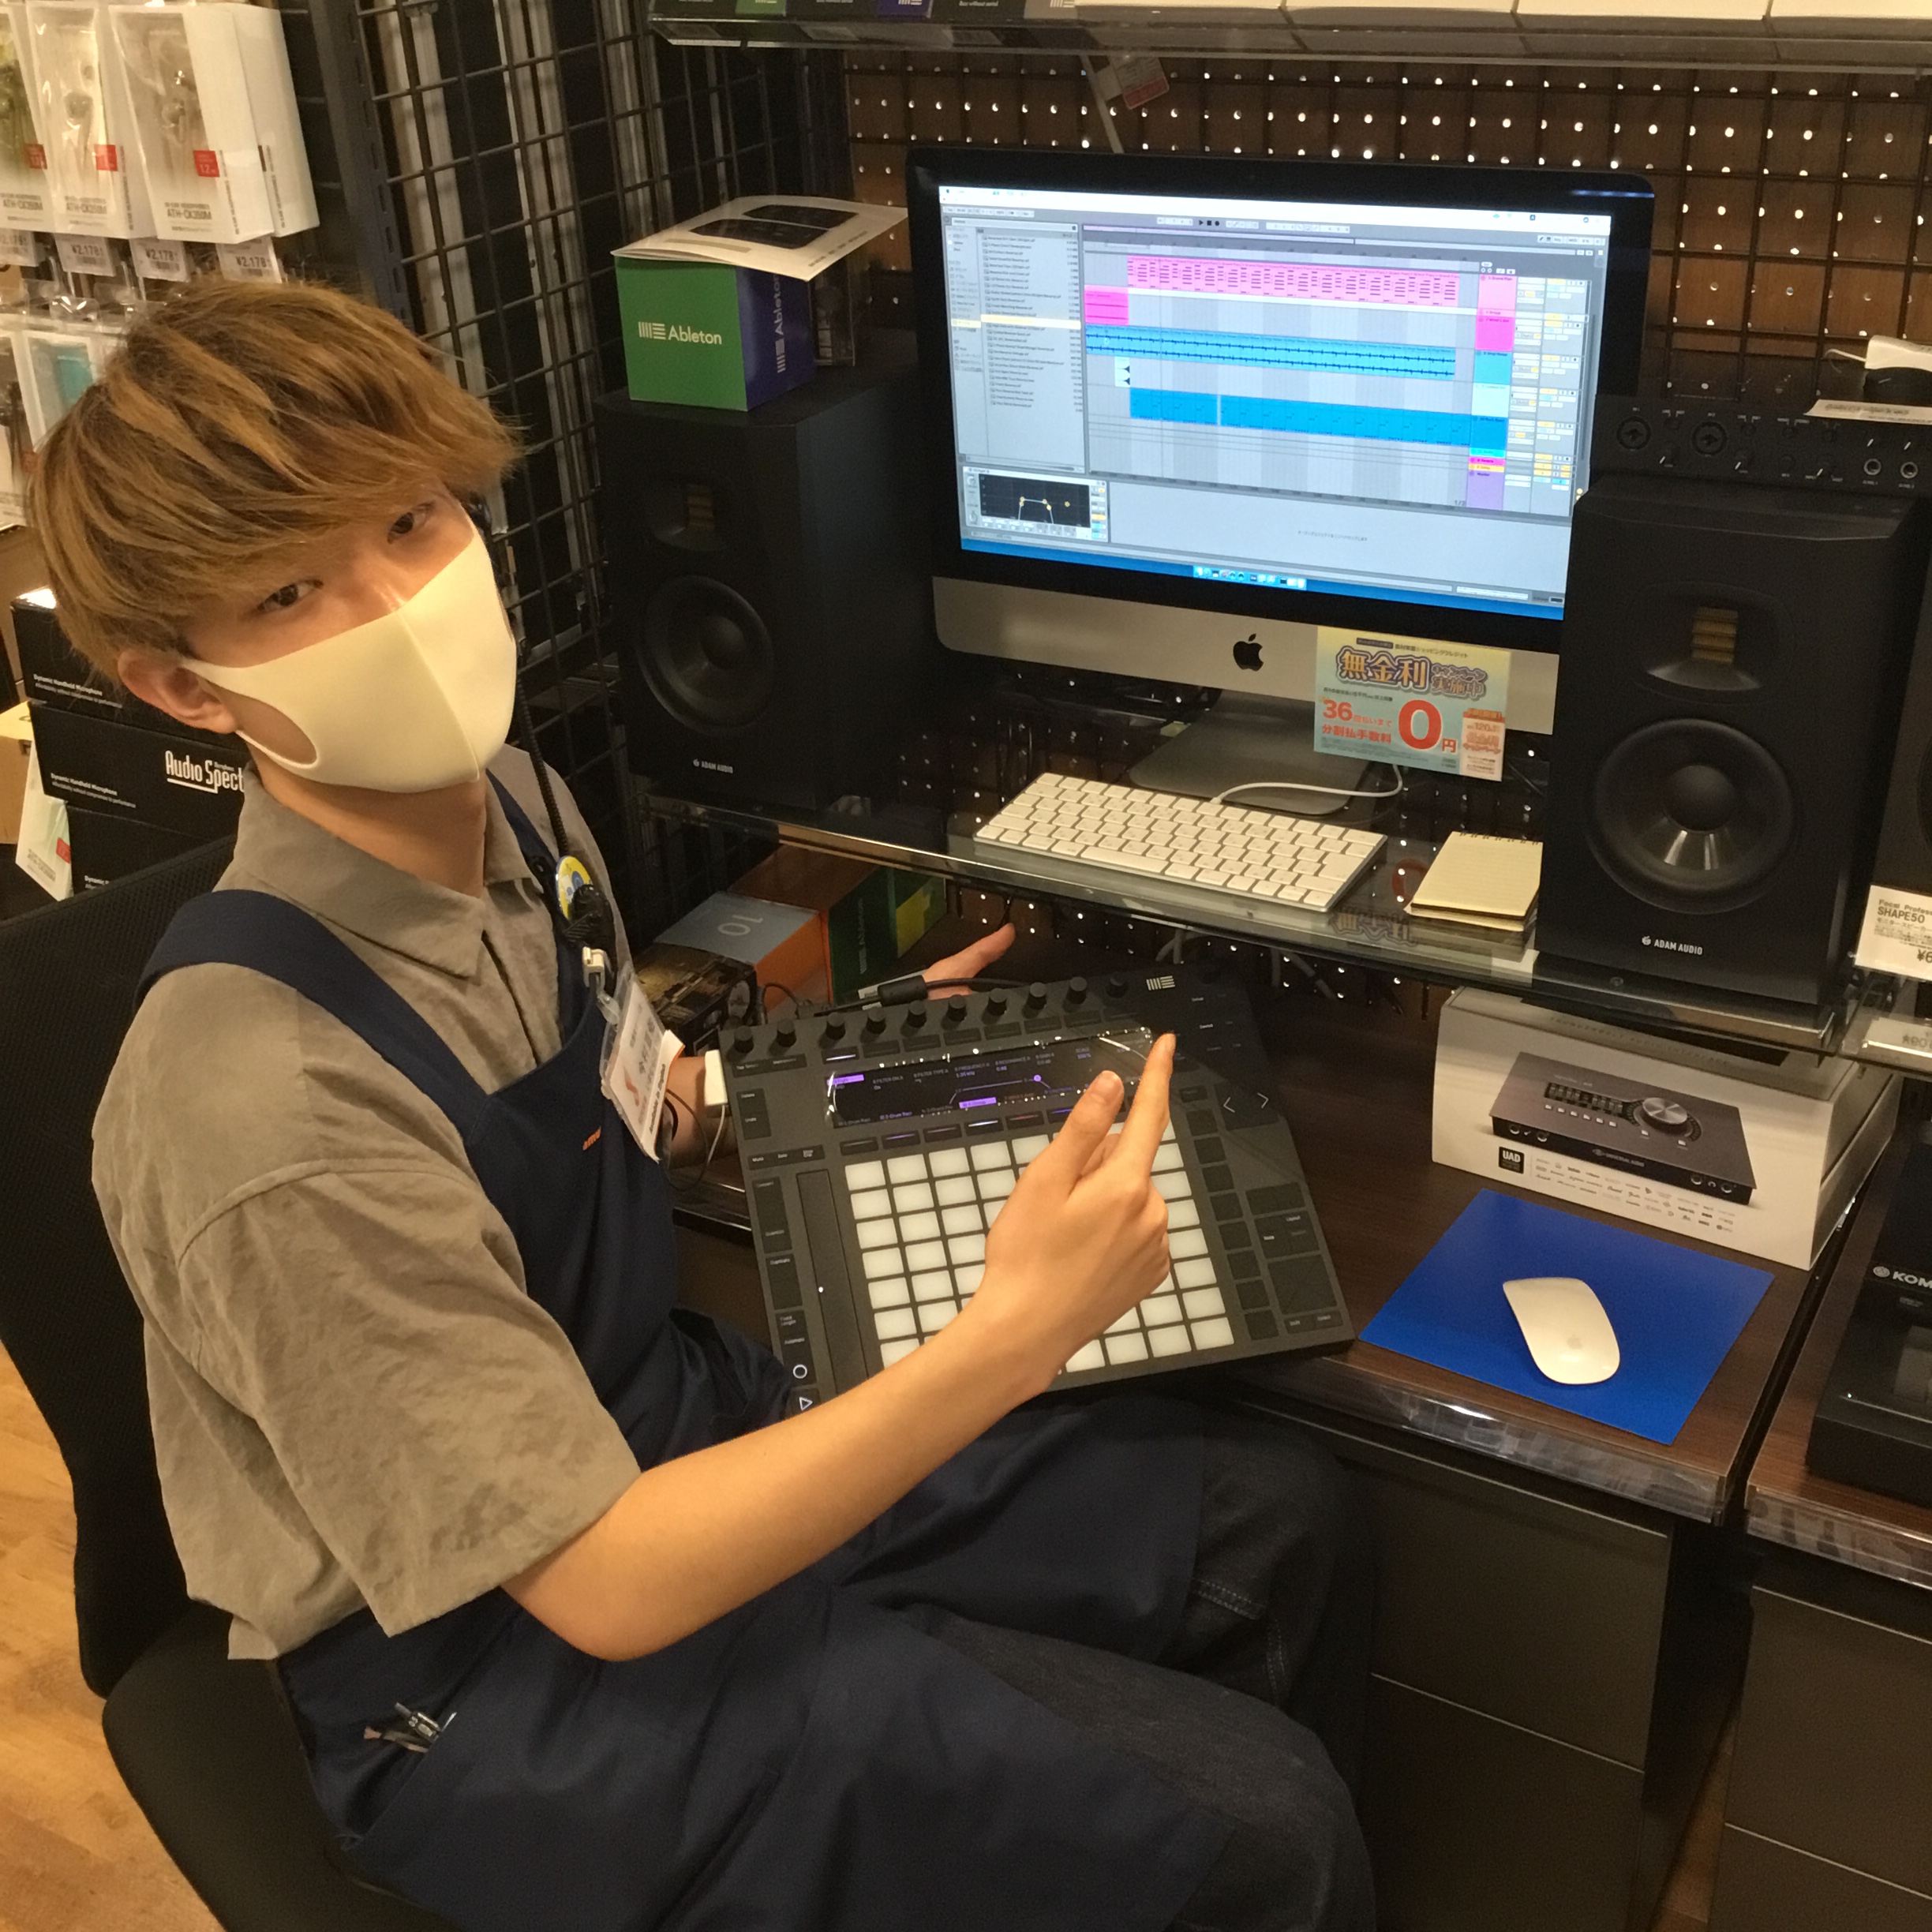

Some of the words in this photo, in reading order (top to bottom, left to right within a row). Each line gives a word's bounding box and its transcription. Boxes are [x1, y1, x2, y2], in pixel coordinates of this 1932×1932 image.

[668, 327, 721, 346] Ableton
[1339, 648, 1429, 691] 無金利
[1432, 677, 1483, 698] 実施中
[165, 751, 204, 782] Audio
[51, 773, 70, 784] Dynamic
[69, 778, 92, 789] Handheld
[91, 784, 118, 796] Microphone
[1879, 899, 1900, 909] Focal
[1877, 906, 1926, 924] SHAPE50
[1654, 938, 1678, 951] ADAM
[1678, 943, 1703, 956] AUDIO
[1502, 1150, 1522, 1163] UAD
[1893, 1271, 1932, 1289] KOM
